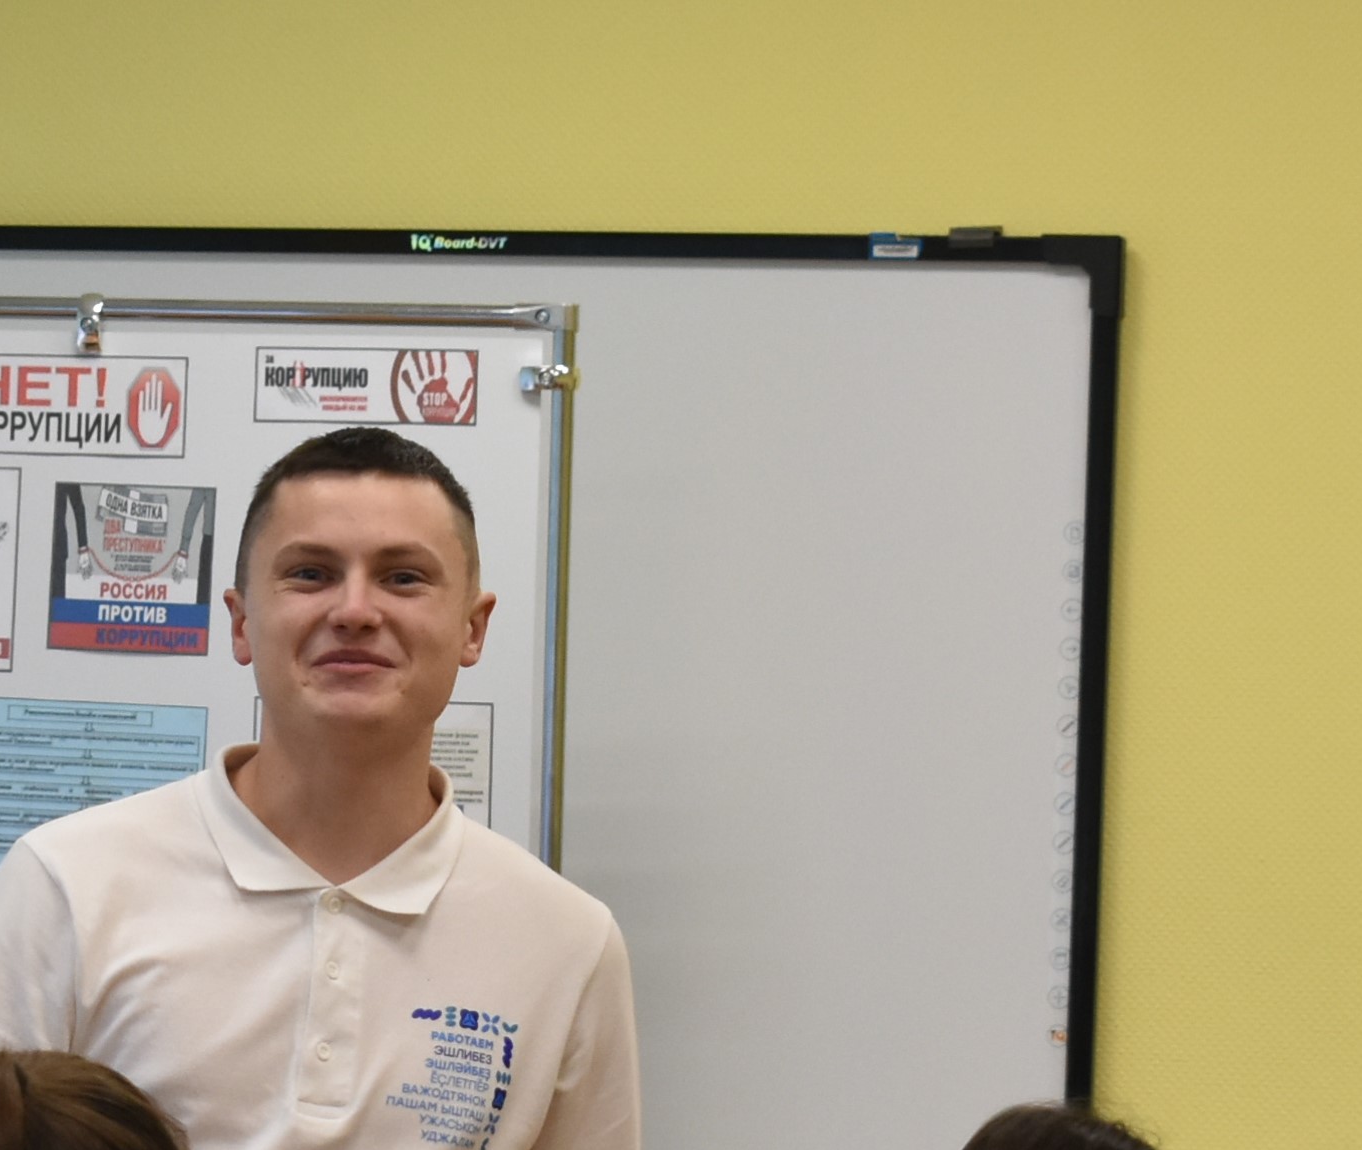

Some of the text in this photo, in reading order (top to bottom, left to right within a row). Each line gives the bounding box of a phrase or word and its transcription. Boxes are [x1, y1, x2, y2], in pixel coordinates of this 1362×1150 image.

[423, 392, 447, 407] STOP
[106, 493, 163, 519] ОДНА ВЗЯТКА
[100, 582, 167, 600] РОССИЯ
[98, 604, 167, 624] ПРОТИВ
[96, 628, 199, 649] КОРРУПЦИИ
[431, 1031, 494, 1050] РАБОТАЕМ
[433, 1045, 493, 1065] ЭШЛИБЕЗ
[386, 1096, 437, 1112] ПАШАМ
